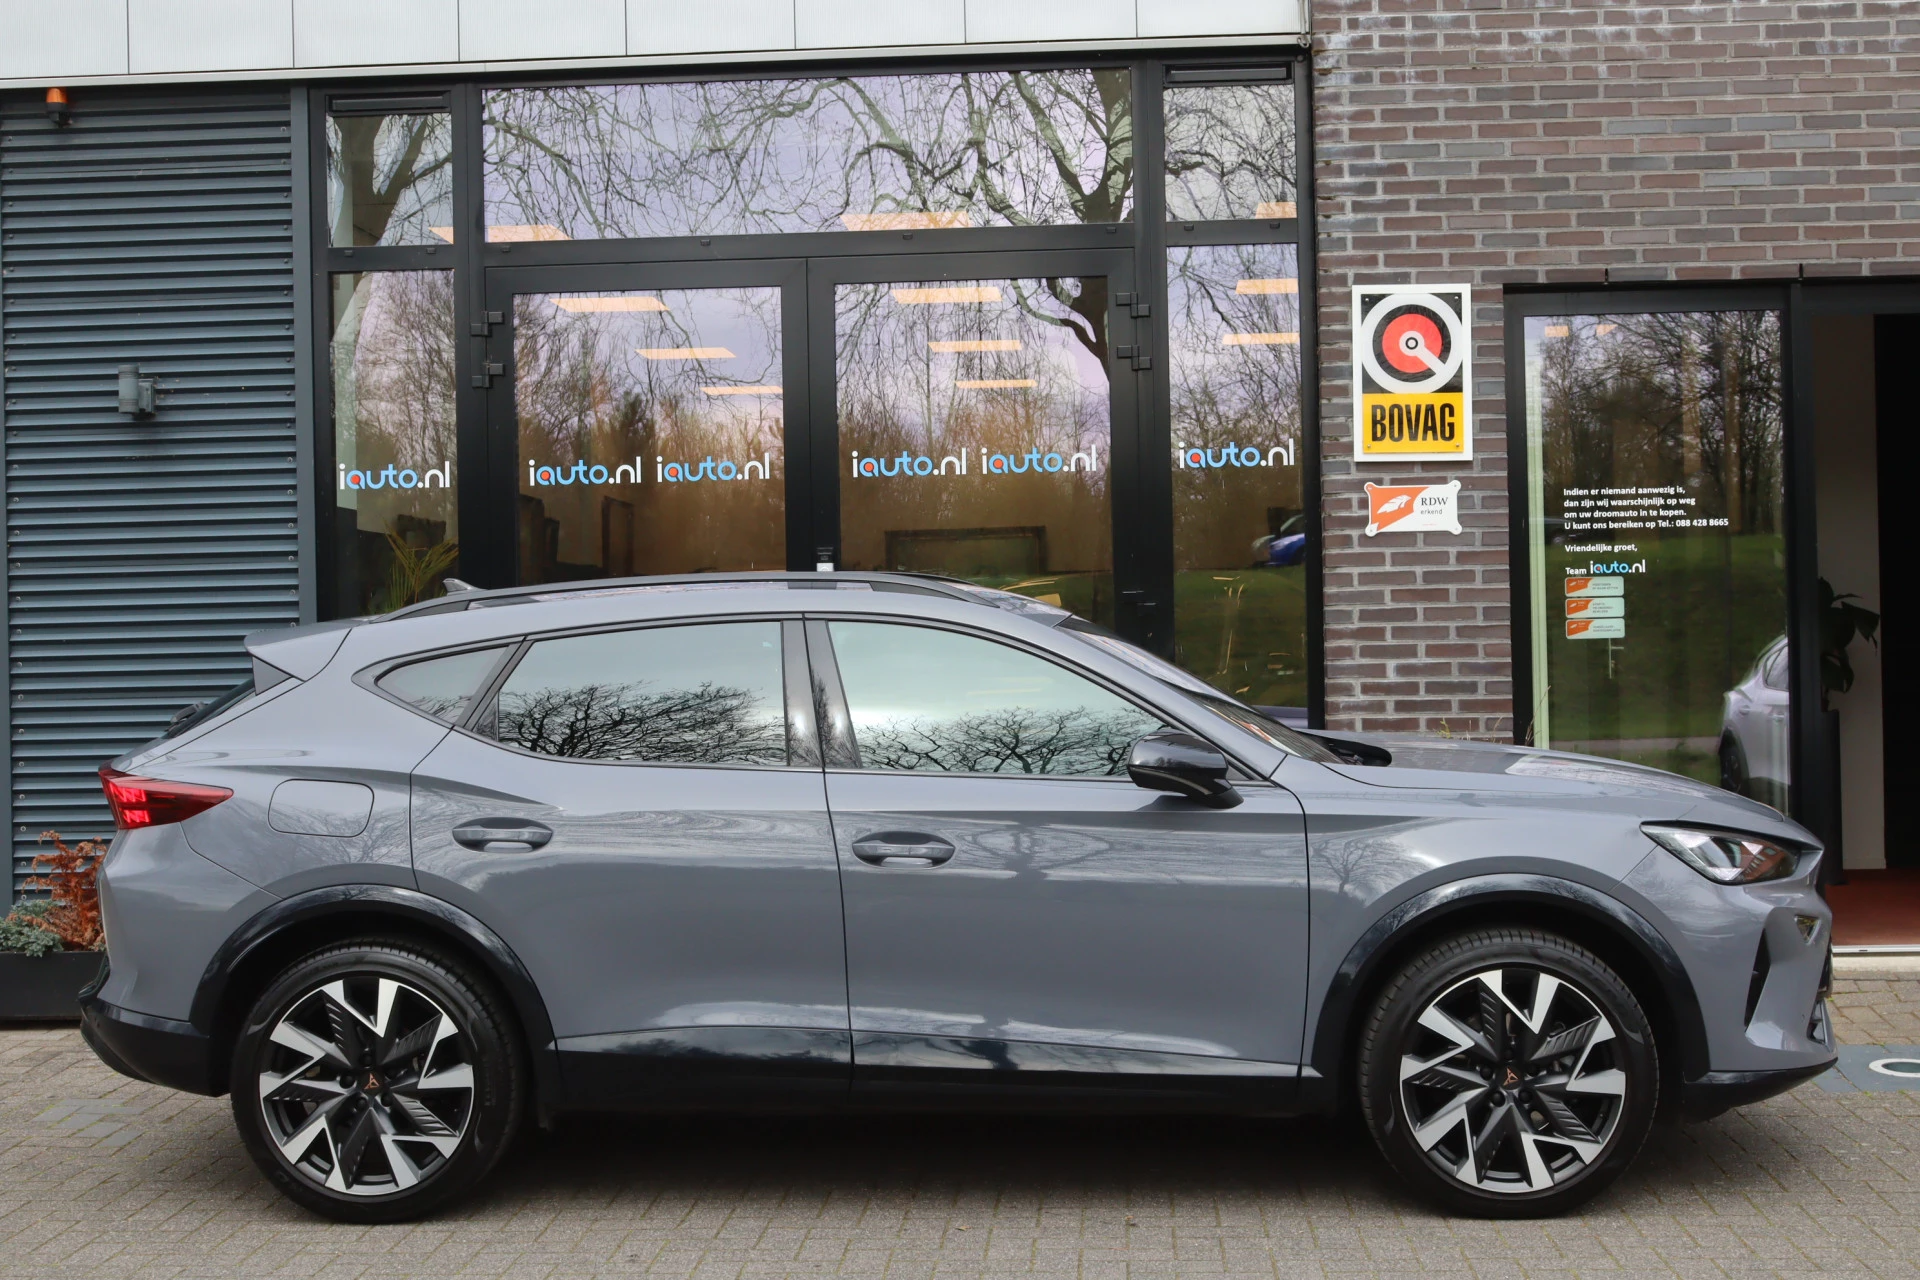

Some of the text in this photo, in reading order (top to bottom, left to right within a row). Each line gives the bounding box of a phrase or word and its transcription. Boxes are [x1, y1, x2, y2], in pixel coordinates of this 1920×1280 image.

[1371, 403, 1455, 442] BOVAG
[1178, 438, 1295, 470] iauto.nl
[851, 444, 1097, 478] iauto.nl iauto.nl
[339, 461, 450, 490] iauto.nl
[528, 452, 770, 487] iauto.nl iauto.nl
[1638, 486, 1674, 496] aanwezig
[1677, 486, 1685, 494] is,
[1421, 497, 1448, 506] RDW
[1581, 499, 1594, 508] zijn
[1596, 499, 1609, 507] wij
[1611, 497, 1665, 506] waarschijnlijk
[1679, 498, 1695, 506] weg
[1593, 509, 1638, 517] droomauto
[1659, 508, 1686, 517] kopen.
[1609, 520, 1643, 528] bereiken
[1565, 544, 1637, 552] Vriendelijke groet,
[1590, 559, 1645, 574] iauto.nl
